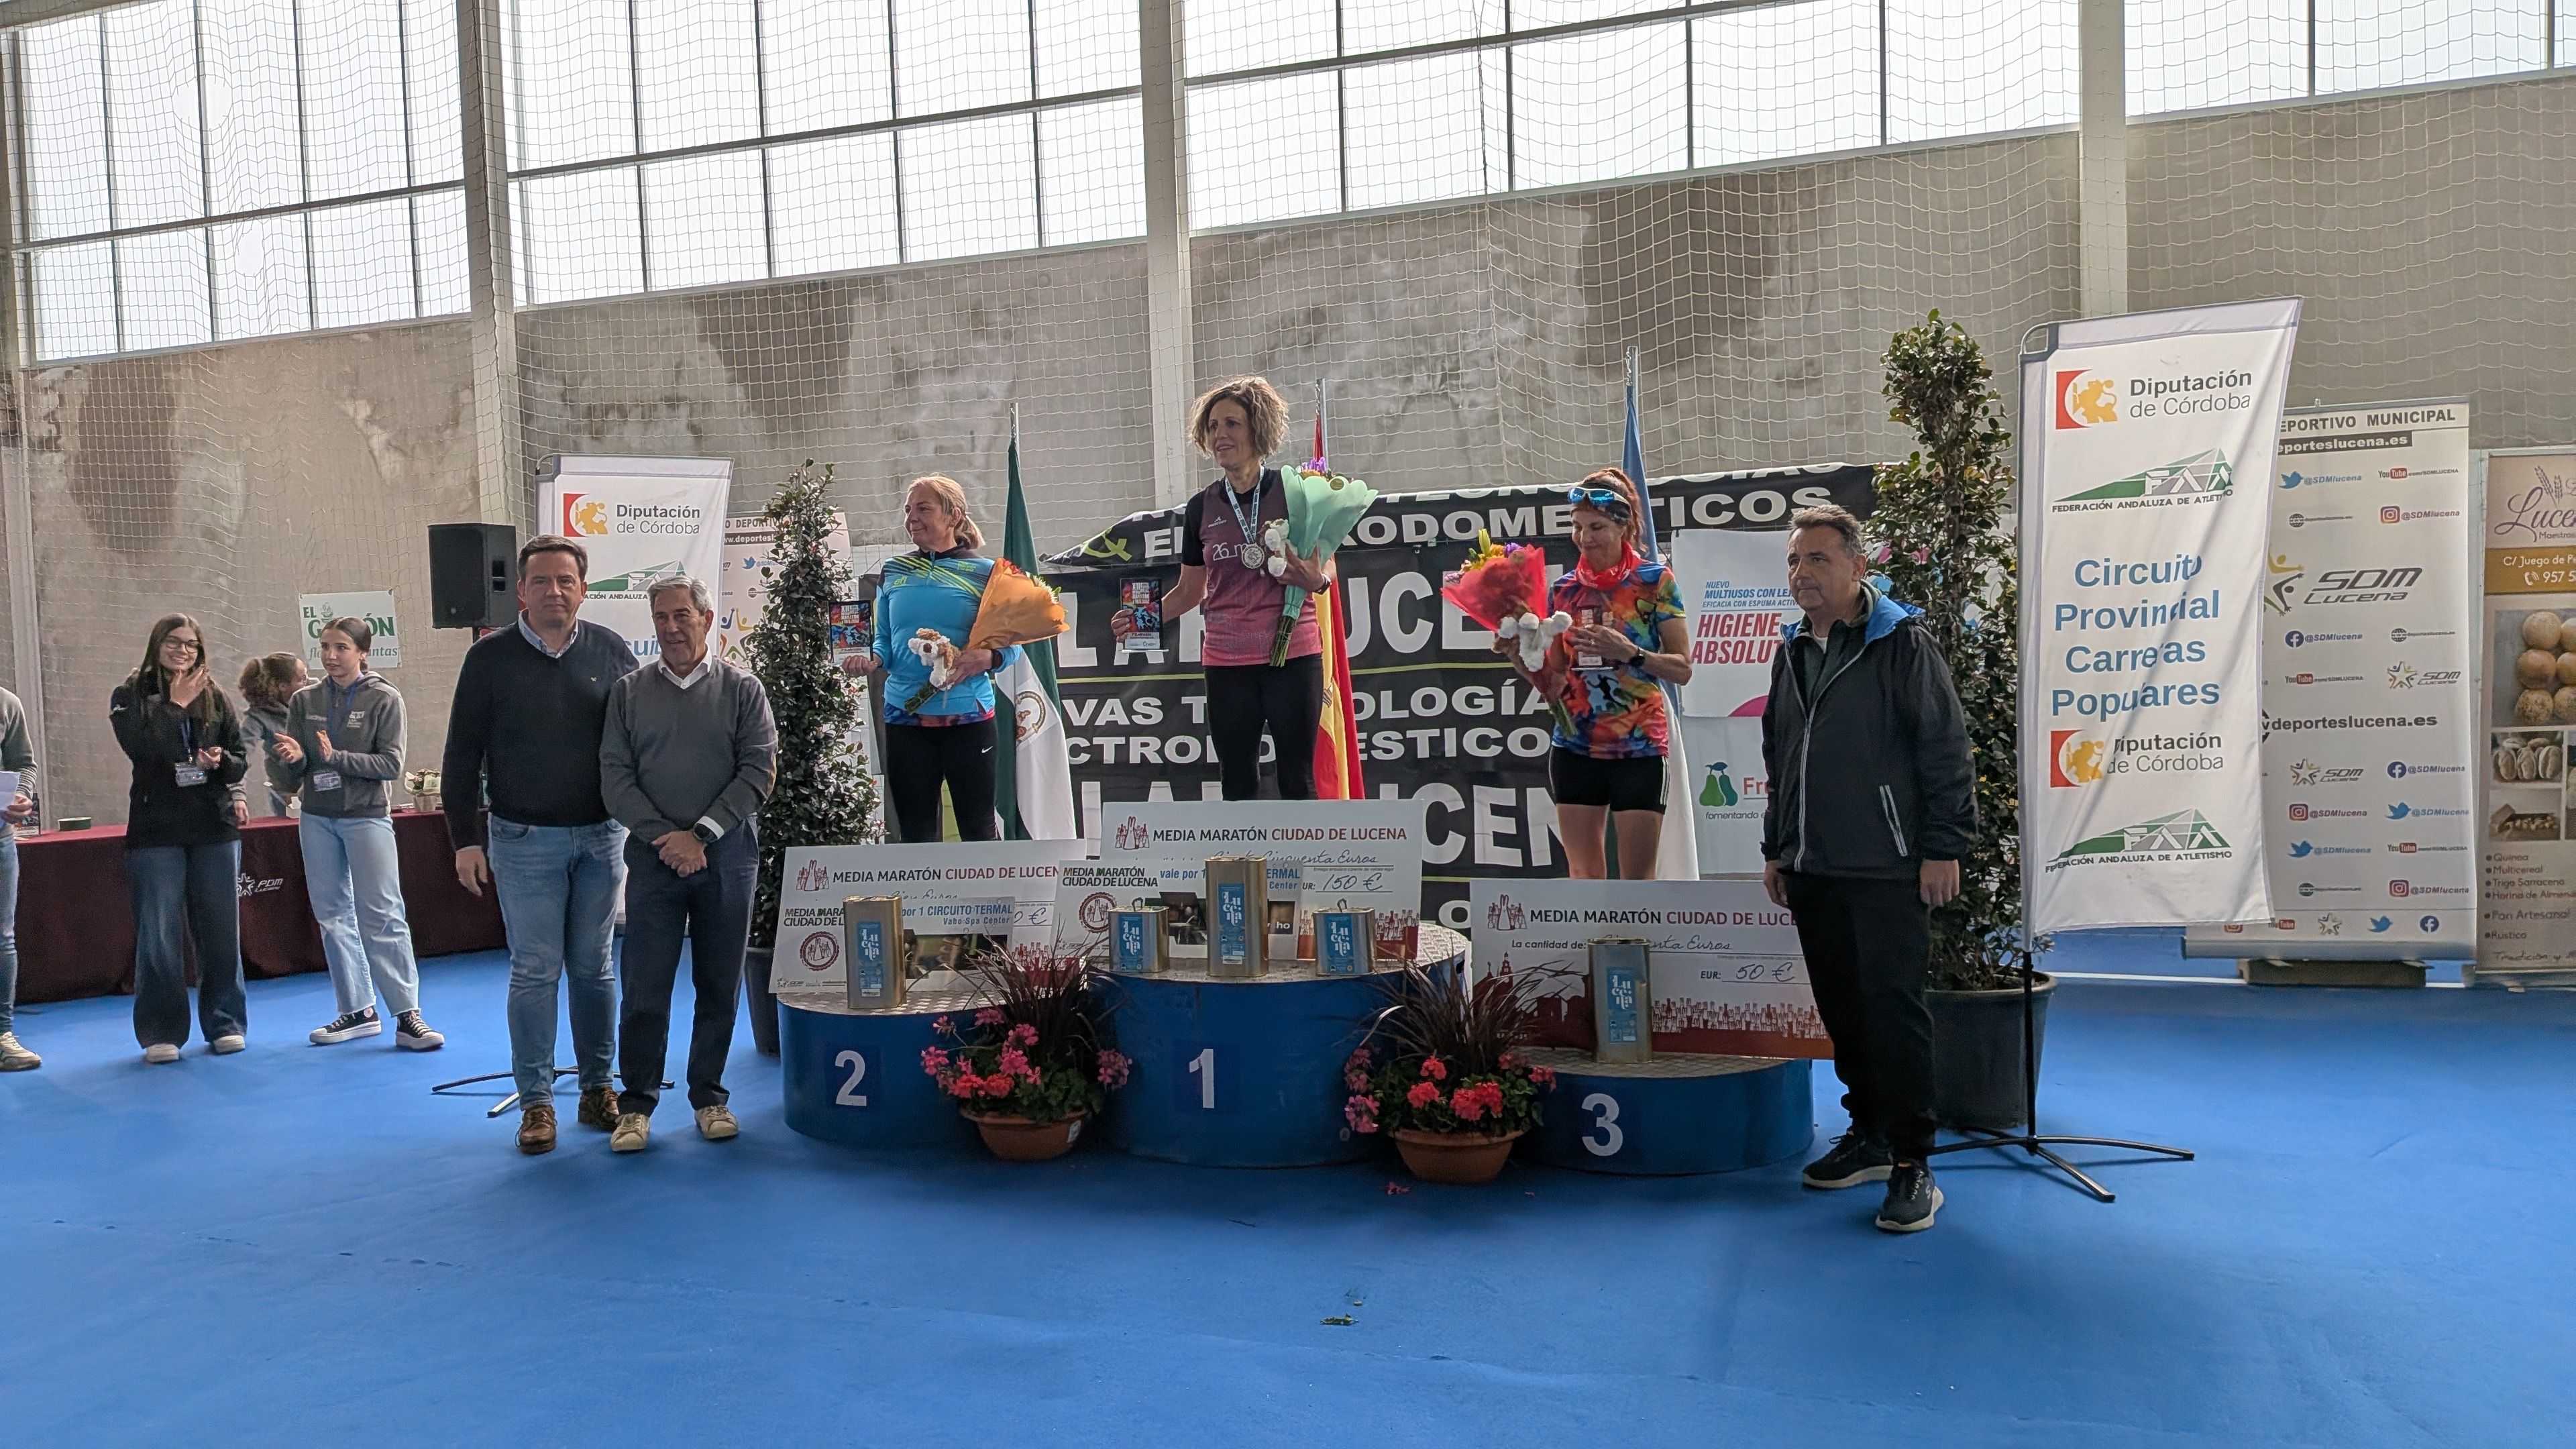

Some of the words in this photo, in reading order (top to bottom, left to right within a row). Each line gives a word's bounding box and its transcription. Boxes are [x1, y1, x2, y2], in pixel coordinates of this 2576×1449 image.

[2130, 370, 2252, 398] Diputación
[2130, 398, 2156, 418] de
[2163, 393, 2251, 415] Córdoba
[2280, 415, 2356, 432] EPORTIVO
[2367, 409, 2455, 427] MUNICIPAL
[2277, 436, 2408, 455] eporteslucena.es
[2052, 500, 2112, 513] FEDERACIÓN
[2117, 498, 2173, 510] ANDALUZA
[2177, 497, 2190, 505] DE
[616, 504, 700, 520] Diputación
[616, 520, 635, 533] de
[640, 521, 700, 534] Córdoba
[2518, 556, 2549, 568] Juego
[2553, 555, 2565, 565] de
[2312, 568, 2423, 592] SDM
[2542, 571, 2565, 583] 957
[584, 592, 606, 600] ACIÓN
[1704, 589, 1755, 599] MULTIUSOS
[1756, 588, 1776, 598] CON
[2303, 592, 2408, 604] Lucena
[303, 606, 317, 619] EL
[1697, 612, 1782, 638] HIGIENE
[1692, 639, 1782, 665] ABSOLUT
[1062, 696, 1164, 727] VAS
[2136, 753, 2224, 773] Córdoba
[1705, 811, 1759, 820] fomentando
[1152, 829, 1195, 842] MEDIA
[1198, 825, 1267, 842] MARATÓN
[1271, 828, 1326, 841] CIUDAD
[1328, 828, 1348, 841] DE
[1350, 827, 1407, 841] LUCENA
[1337, 849, 1379, 864] Euros
[2098, 854, 2153, 863] ANDALUZA
[2157, 853, 2171, 861] DE
[2176, 851, 2233, 861] ATLETISMO
[833, 871, 873, 883] MEDIA
[877, 867, 941, 882] MARATÓN
[945, 867, 996, 880] CIUDAD
[998, 867, 1016, 879] DE
[1019, 866, 1058, 878] LUCEN
[1063, 867, 1095, 877] MEDIA
[1097, 866, 1145, 877] MARATÓN
[1160, 868, 1179, 879] vale
[1182, 871, 1196, 881] por
[1267, 868, 1300, 879] ERMAL
[2492, 865, 2543, 875] Multicereal
[1062, 877, 1102, 887] CIUDAD
[1103, 877, 1117, 886] DE
[1118, 877, 1158, 887] LUCENA
[1269, 881, 1298, 890] Center
[1303, 882, 1316, 890] UR:
[1323, 873, 1357, 891] 150
[2526, 891, 2538, 899] de
[784, 908, 815, 918] MEDIA
[817, 907, 845, 917] MARA
[919, 906, 924, 916] 1
[927, 906, 972, 916] CIRCUITO
[975, 904, 1013, 915] TERMAL
[1530, 910, 1579, 923] MEDIA
[1584, 908, 1661, 924] MARATÓN
[1666, 911, 1727, 925] CIUDAD
[1733, 912, 1754, 925] DE
[784, 918, 823, 926] CIUDAD
[823, 917, 838, 926] DE
[983, 916, 1010, 925] Center
[1511, 940, 1522, 948] La
[1525, 940, 1568, 949] cantidad
[1570, 941, 1587, 949] de:
[1686, 934, 1732, 950] Euros
[1701, 971, 1721, 979] EUR:
[1736, 964, 1764, 981] 50
[835, 1050, 867, 1107] 2
[1189, 1049, 1215, 1109] 1
[1581, 1093, 1623, 1157] 3
